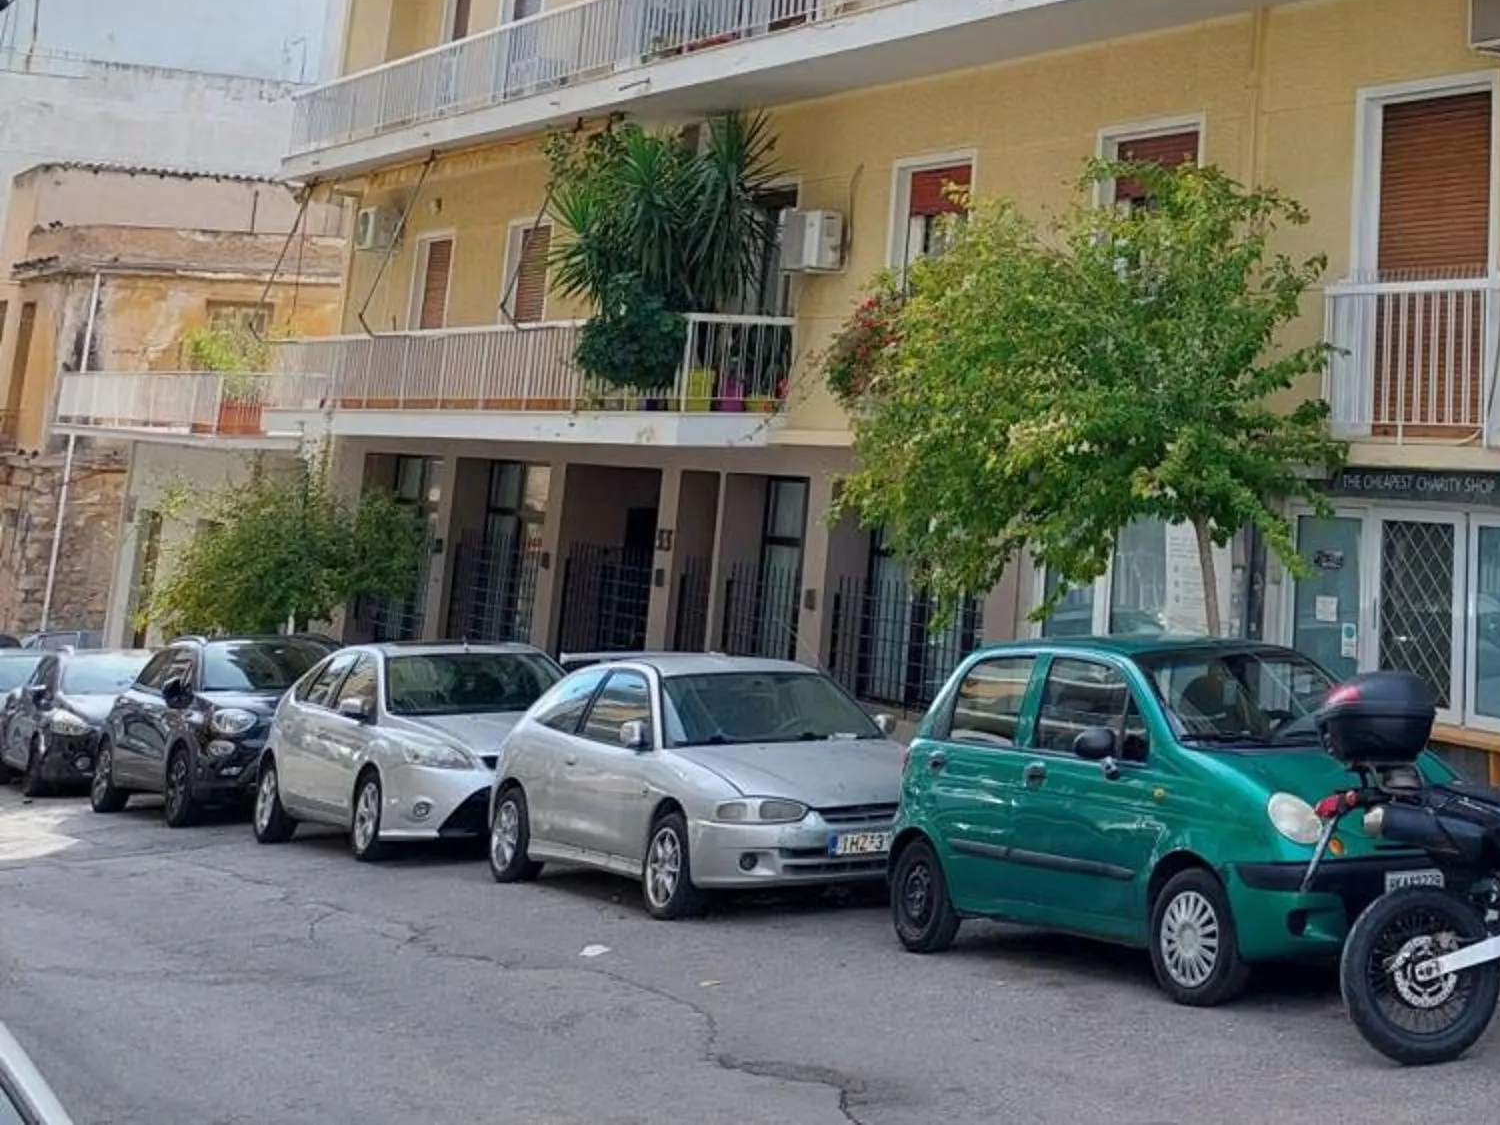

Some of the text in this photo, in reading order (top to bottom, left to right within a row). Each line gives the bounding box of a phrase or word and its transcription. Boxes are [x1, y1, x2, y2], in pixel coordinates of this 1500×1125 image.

[1343, 475, 1362, 490] THE
[1363, 475, 1411, 491] CHEAPEST
[1416, 476, 1461, 492] CHARITY
[1464, 476, 1494, 493] SHOP
